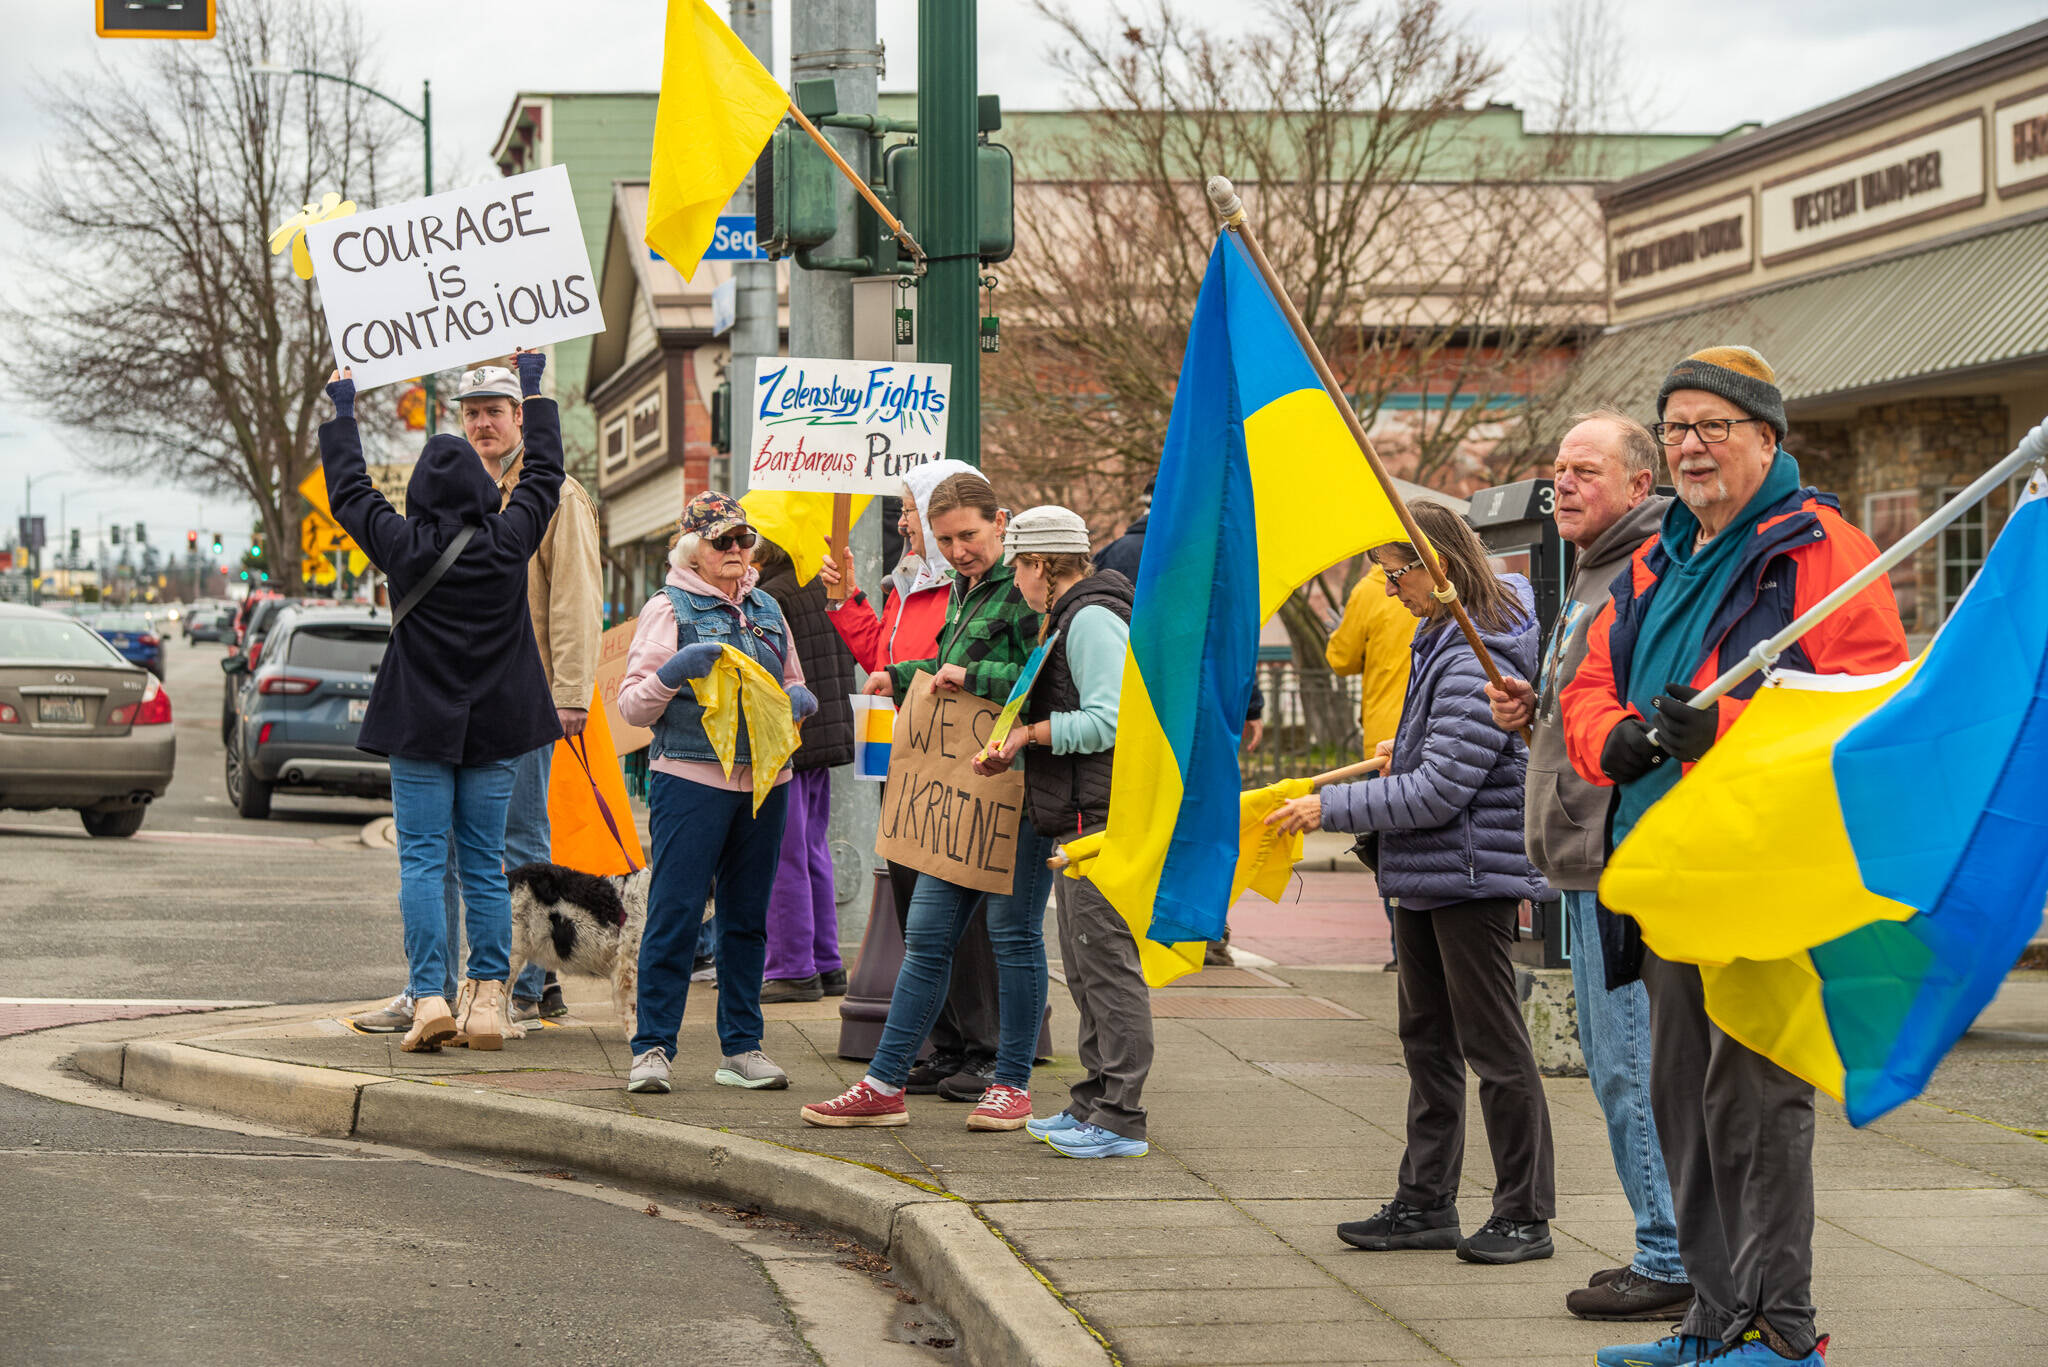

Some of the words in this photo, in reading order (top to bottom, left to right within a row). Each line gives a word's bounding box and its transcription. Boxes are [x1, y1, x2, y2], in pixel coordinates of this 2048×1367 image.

[333, 191, 550, 273] COURAGE
[714, 224, 766, 259] Seq
[759, 364, 863, 421] Zelenskyy
[863, 366, 946, 423] Fights
[908, 689, 957, 759] WE
[882, 765, 1017, 874] UKRAINE
[1743, 1330, 1761, 1342] OKA
